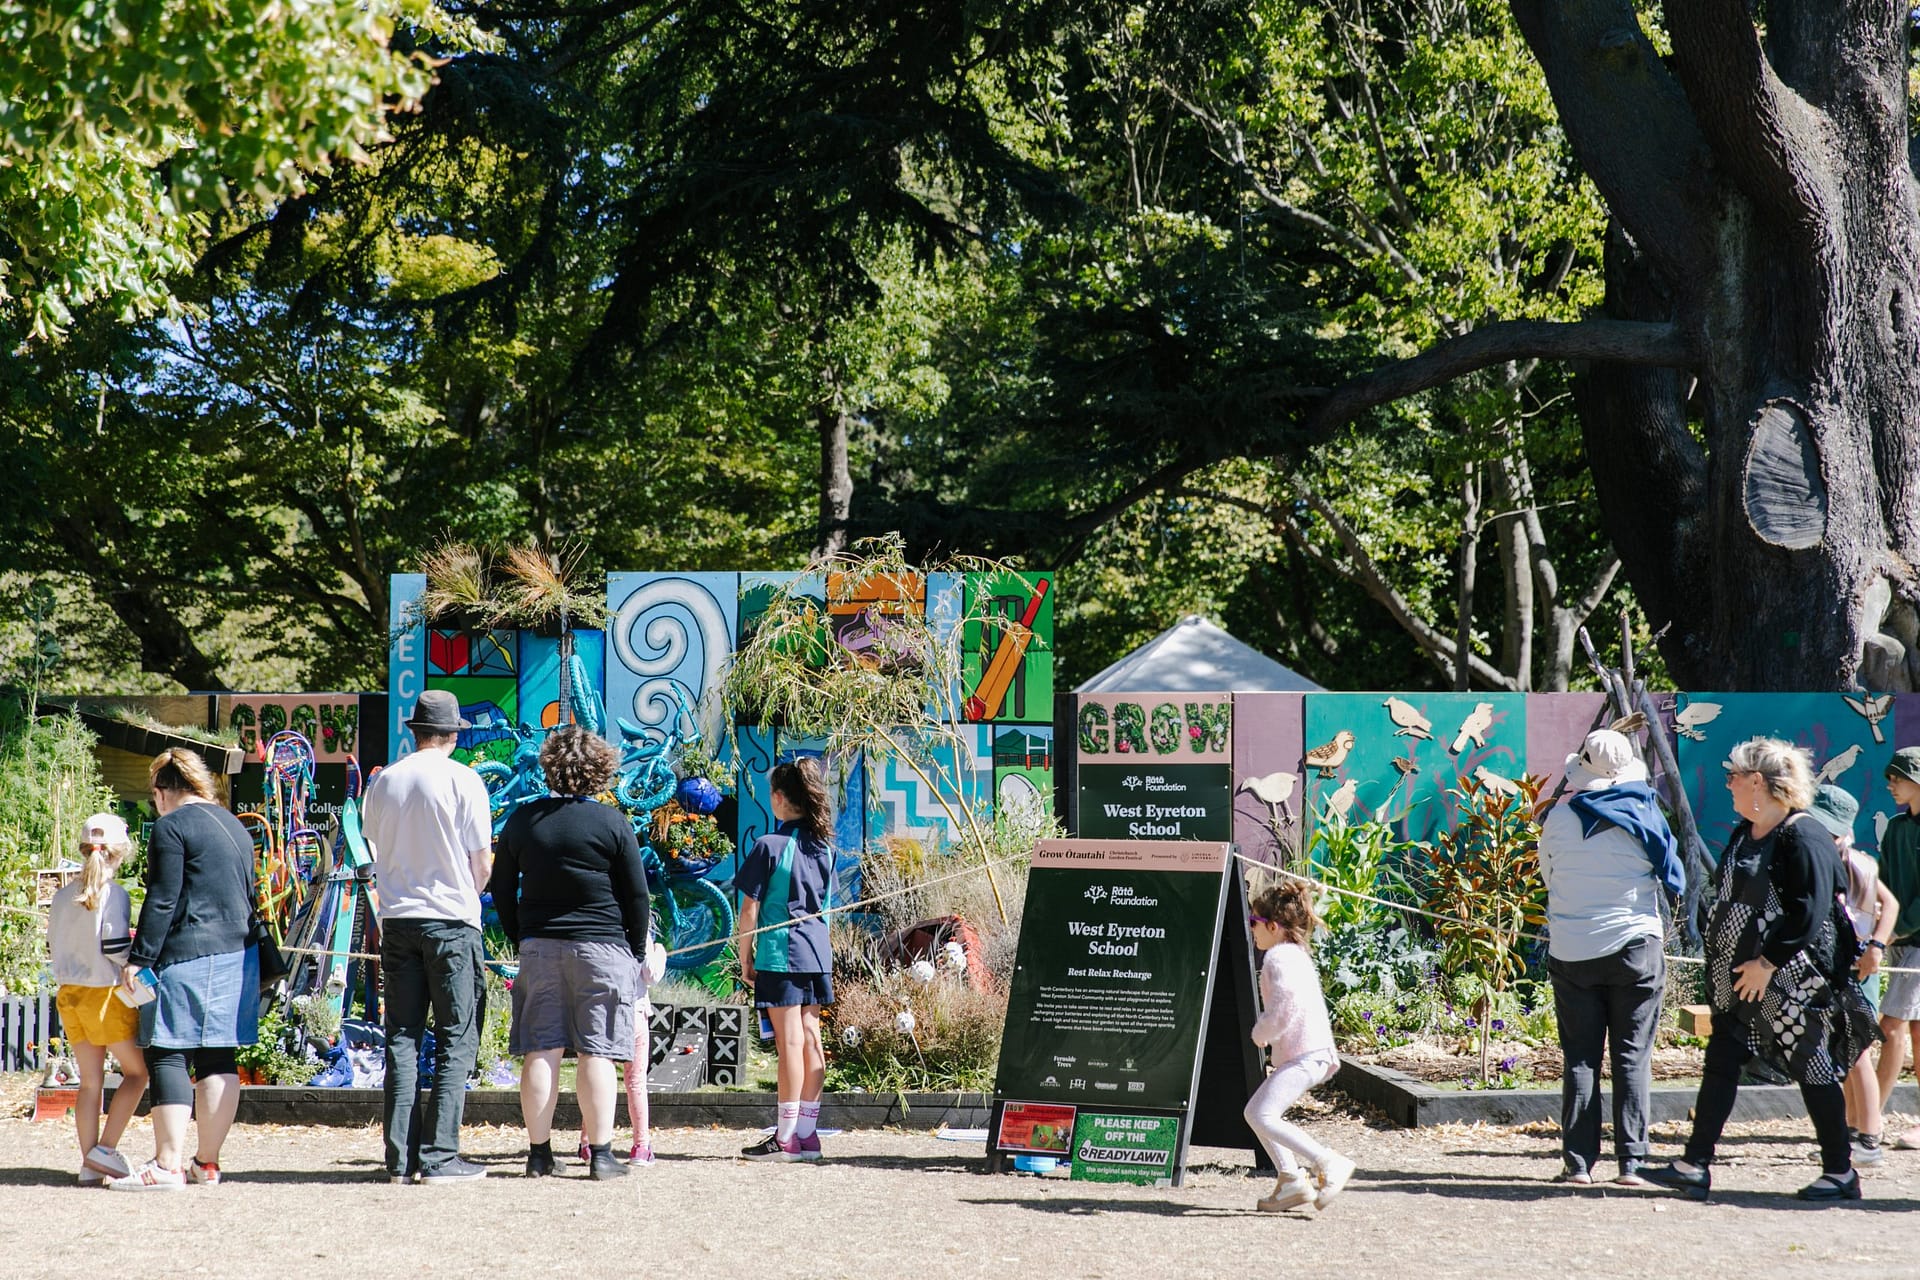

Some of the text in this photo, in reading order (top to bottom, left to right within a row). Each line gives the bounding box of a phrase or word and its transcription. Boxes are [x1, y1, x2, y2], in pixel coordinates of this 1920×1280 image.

[1079, 702, 1230, 755] GROW
[1146, 776, 1164, 784] Rātā
[1146, 784, 1186, 792] Foundation
[310, 802, 344, 815] Colleg
[1104, 804, 1206, 820] West Eyreton
[1129, 822, 1181, 836] School
[1039, 850, 1064, 858] Grow
[1112, 886, 1134, 896] Rātā
[1110, 896, 1158, 906] Foundation
[1068, 922, 1166, 941] West Eyreton
[1088, 940, 1139, 956] School
[1068, 968, 1152, 981] Rest Relax Recharge
[1094, 1118, 1160, 1130] PLEASE KEEP
[1104, 1132, 1146, 1142] OFF THE
[1088, 1148, 1167, 1163] READYLAWN
